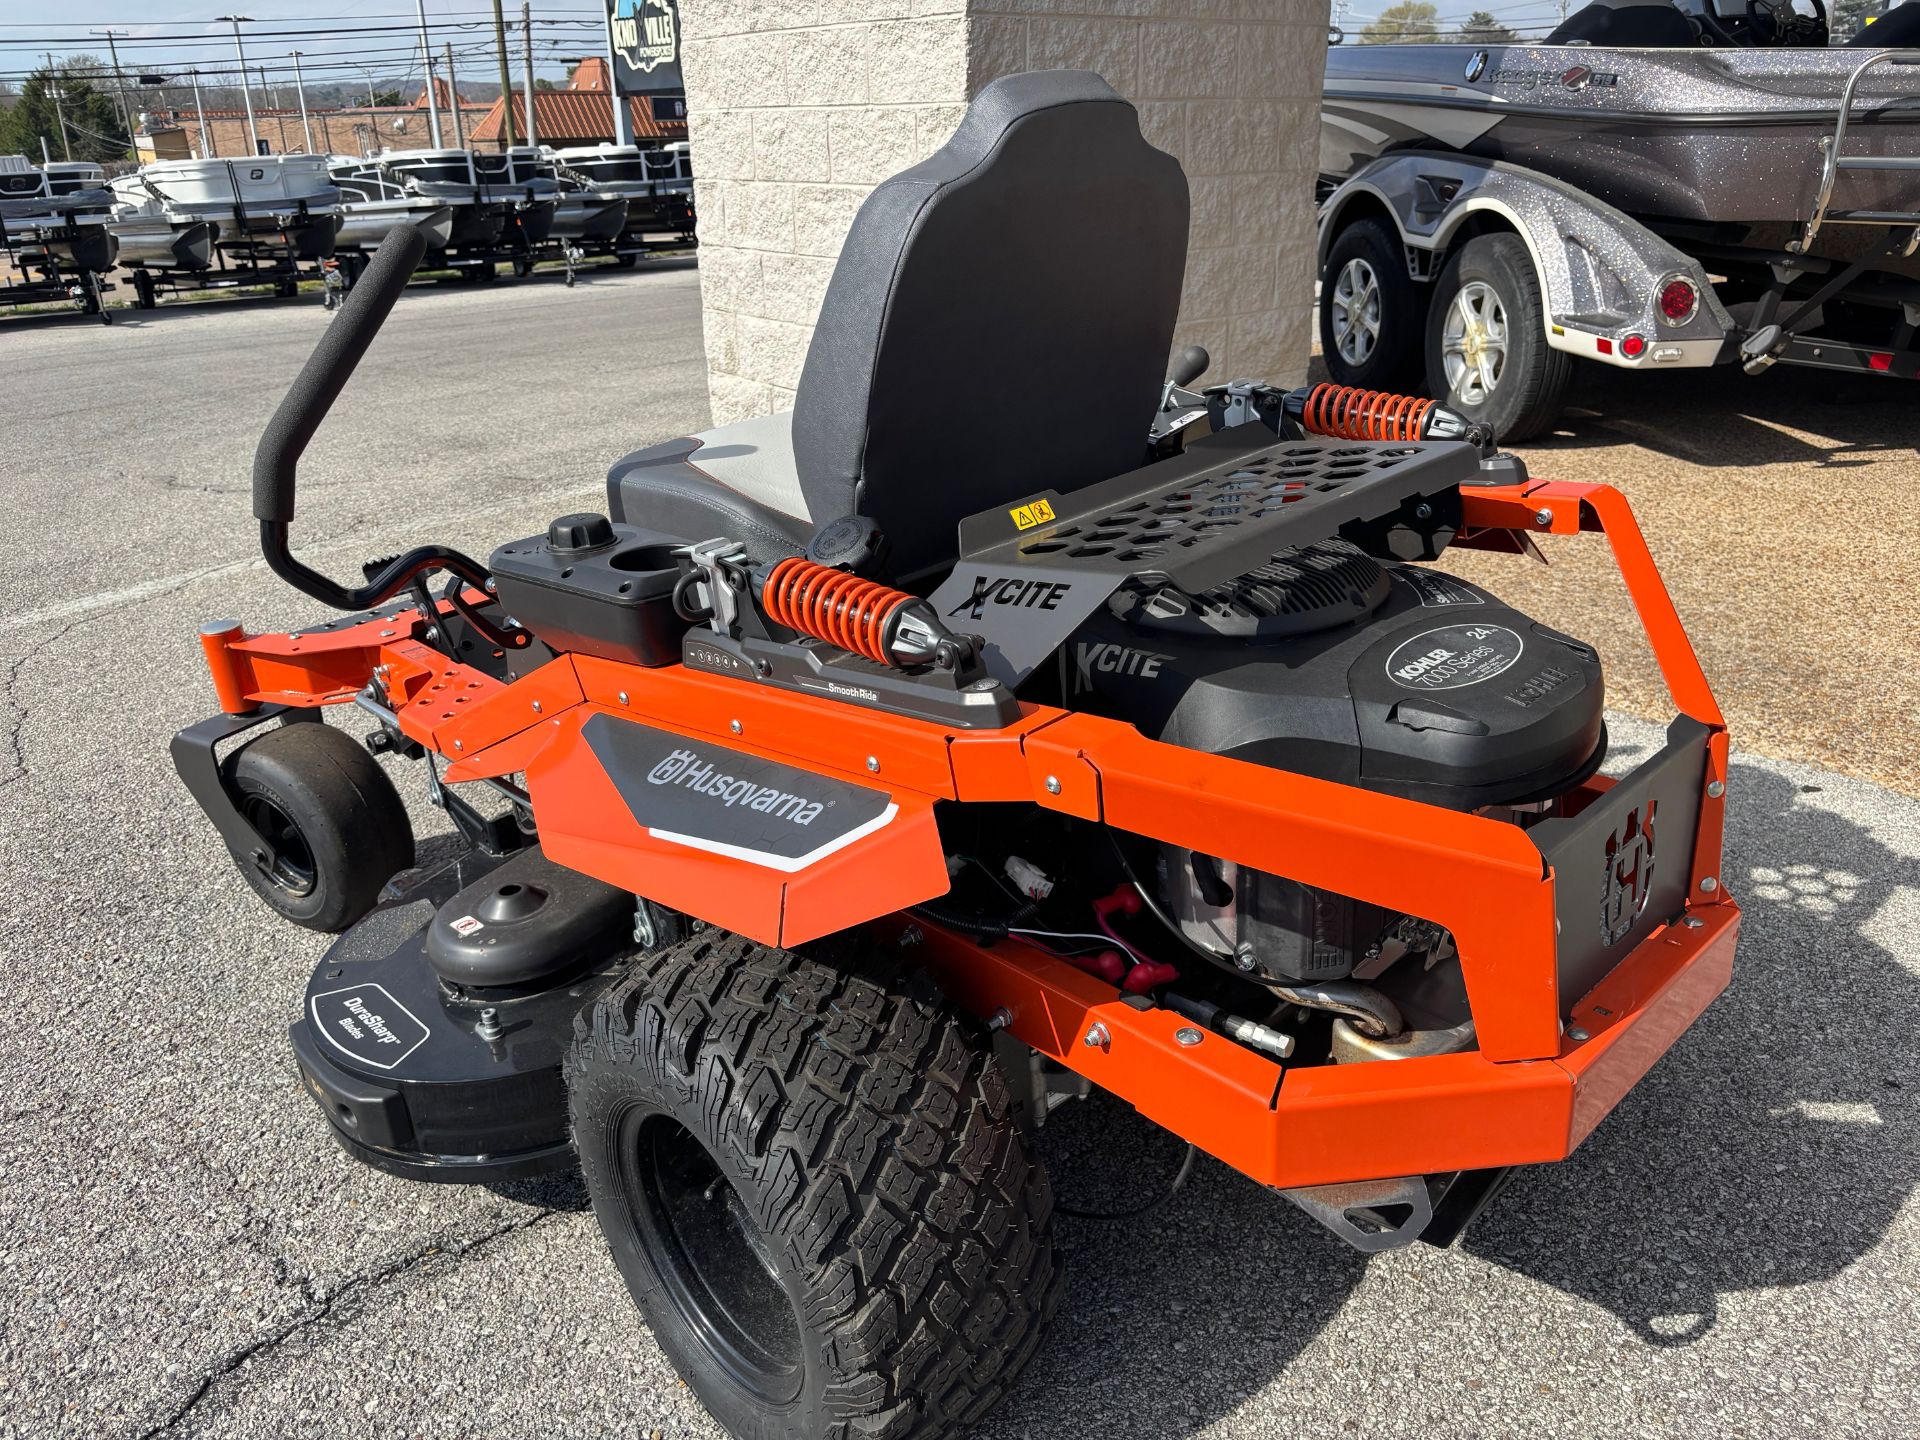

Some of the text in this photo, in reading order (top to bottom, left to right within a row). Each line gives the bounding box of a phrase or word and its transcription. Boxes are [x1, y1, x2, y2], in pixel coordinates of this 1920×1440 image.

[1482, 69, 1562, 90] Ranger
[947, 575, 1072, 621] XCITE
[1466, 627, 1492, 640] 24
[1074, 642, 1178, 696] XCITE
[1394, 648, 1455, 681] KOHLER
[1415, 665, 1458, 687] 7000
[1448, 645, 1495, 669] Series
[673, 760, 824, 826] Husqvarna
[339, 1017, 364, 1040] Blades
[343, 996, 398, 1044] DuraSharp
